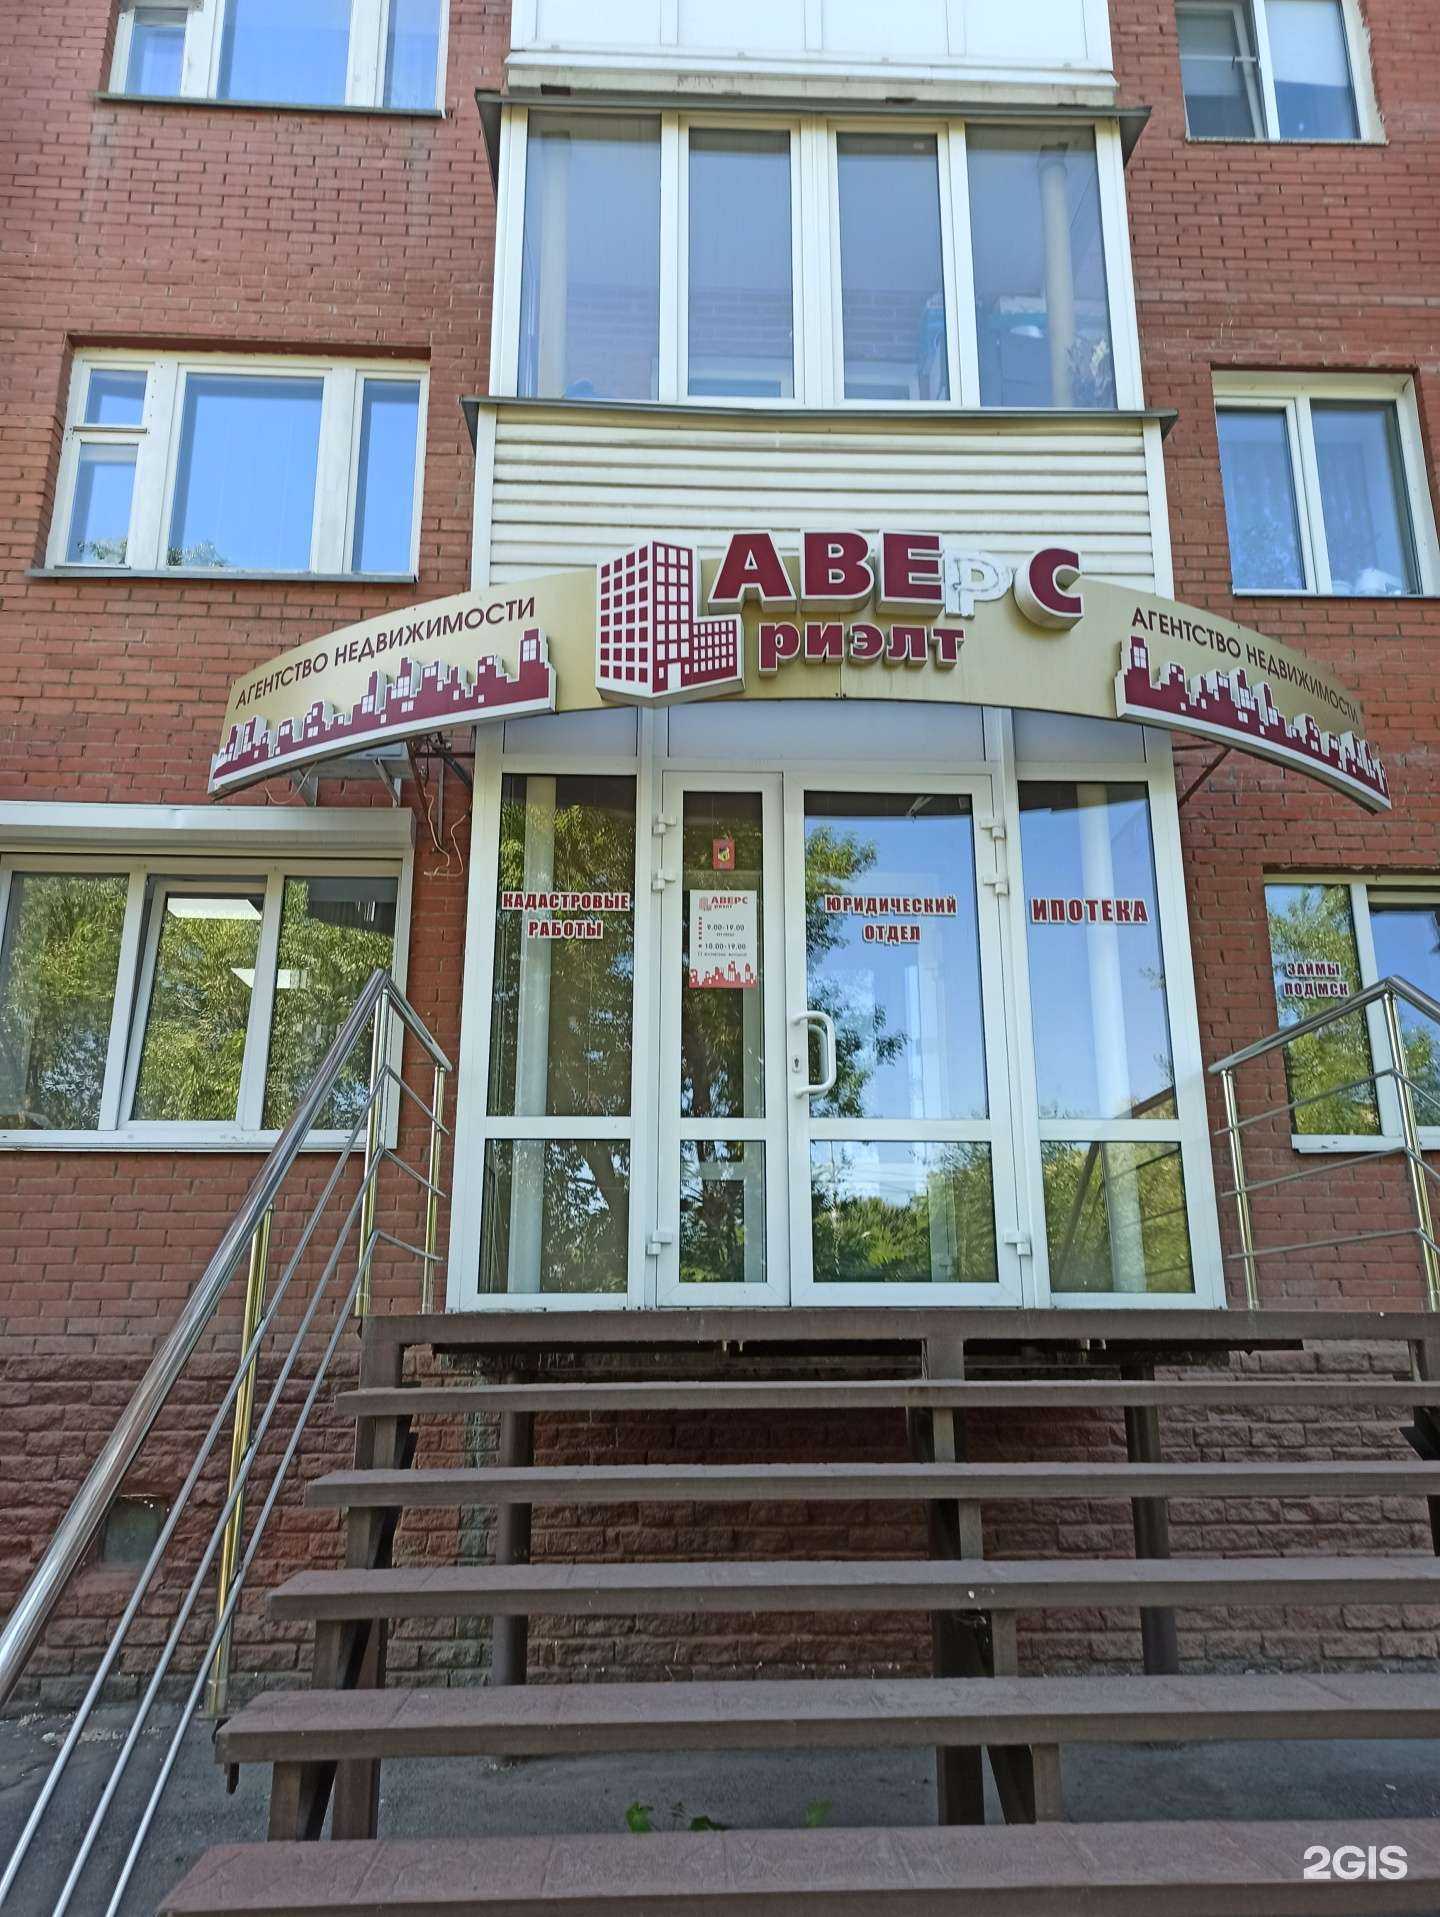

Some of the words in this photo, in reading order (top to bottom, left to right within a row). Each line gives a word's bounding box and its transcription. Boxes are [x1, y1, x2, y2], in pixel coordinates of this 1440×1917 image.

[234, 653, 328, 709] АГЕНТСТВО
[334, 597, 535, 667] НЕДВИЖИМОСТИ
[758, 621, 966, 677] риэлт
[1131, 606, 1242, 659] АГЕНТСТВО
[1245, 643, 1360, 726] НЕДВИЖИМОСТИ
[502, 892, 630, 911] КАДАСТРОВЫЕ
[826, 895, 957, 915] ЮРИДИЧЕСКИЙ
[1031, 899, 1149, 922] ИПОТЕКА
[528, 921, 603, 938] РАБОТЫ
[864, 924, 921, 944] ОТДЕЛ
[1284, 981, 1314, 997] ПОД
[1316, 981, 1349, 997] МСК
